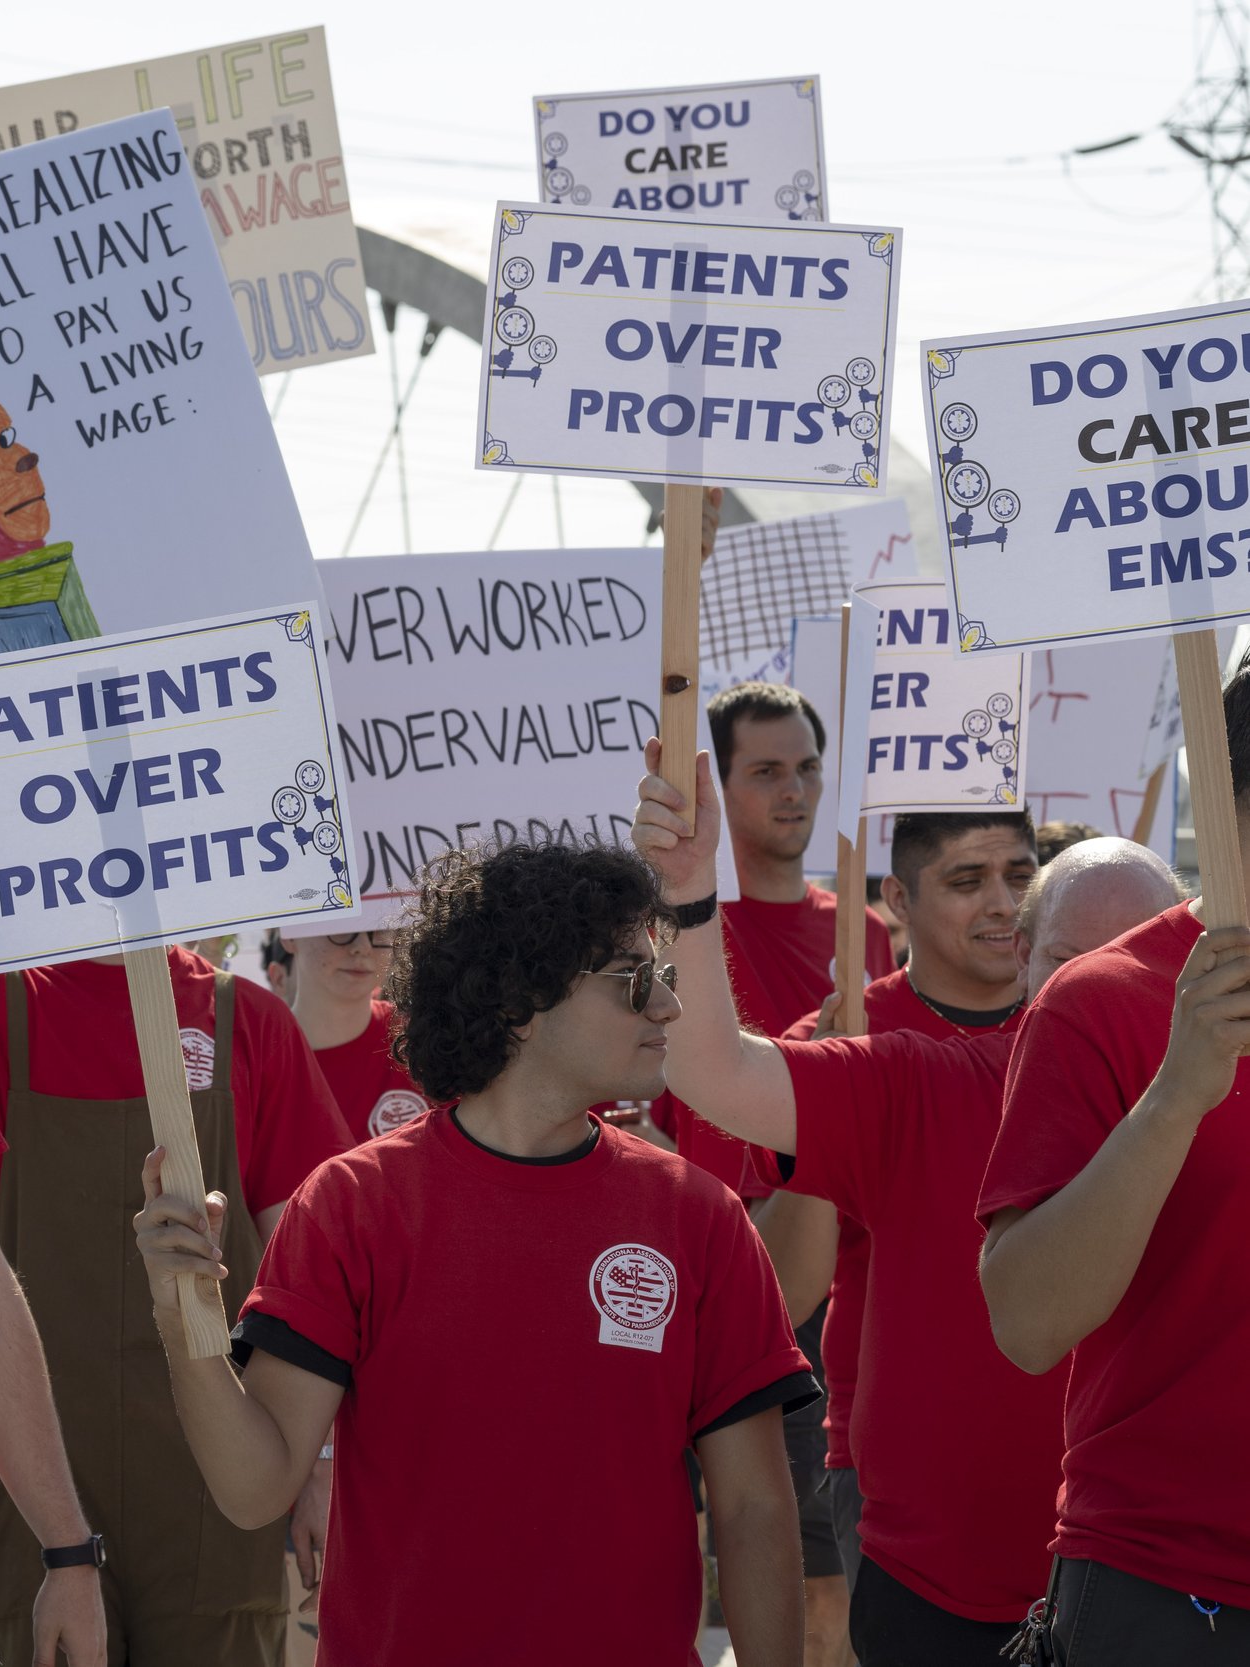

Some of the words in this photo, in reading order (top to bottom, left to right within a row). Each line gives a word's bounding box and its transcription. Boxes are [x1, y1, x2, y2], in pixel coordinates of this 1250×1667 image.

[134, 33, 315, 131] LIFE
[184, 118, 313, 181] ORTH
[599, 108, 656, 138] DO
[664, 99, 751, 133] YOU
[624, 141, 728, 175] CARE
[224, 155, 352, 234] WAGE
[612, 177, 751, 212] ABOUT
[53, 202, 189, 286] HAVE
[547, 240, 850, 301] PATIENTS
[53, 296, 121, 349] PAY
[141, 275, 194, 323] US
[604, 318, 783, 370] OVER
[26, 373, 56, 413] A
[80, 325, 205, 396] LIVING
[1029, 353, 1128, 407] DO
[1141, 332, 1250, 391] YO
[566, 387, 826, 446] PROFITS
[1077, 398, 1250, 465] CARE
[1054, 464, 1250, 534] ABOU
[336, 695, 661, 784] NDERVALUED
[19, 747, 226, 825] OVER
[595, 1248, 635, 1282] INTERNATIONAL
[636, 1248, 674, 1281] ASSOCIATION
[611, 1330, 632, 1339] LOCAL
[616, 1317, 631, 1327] AND
